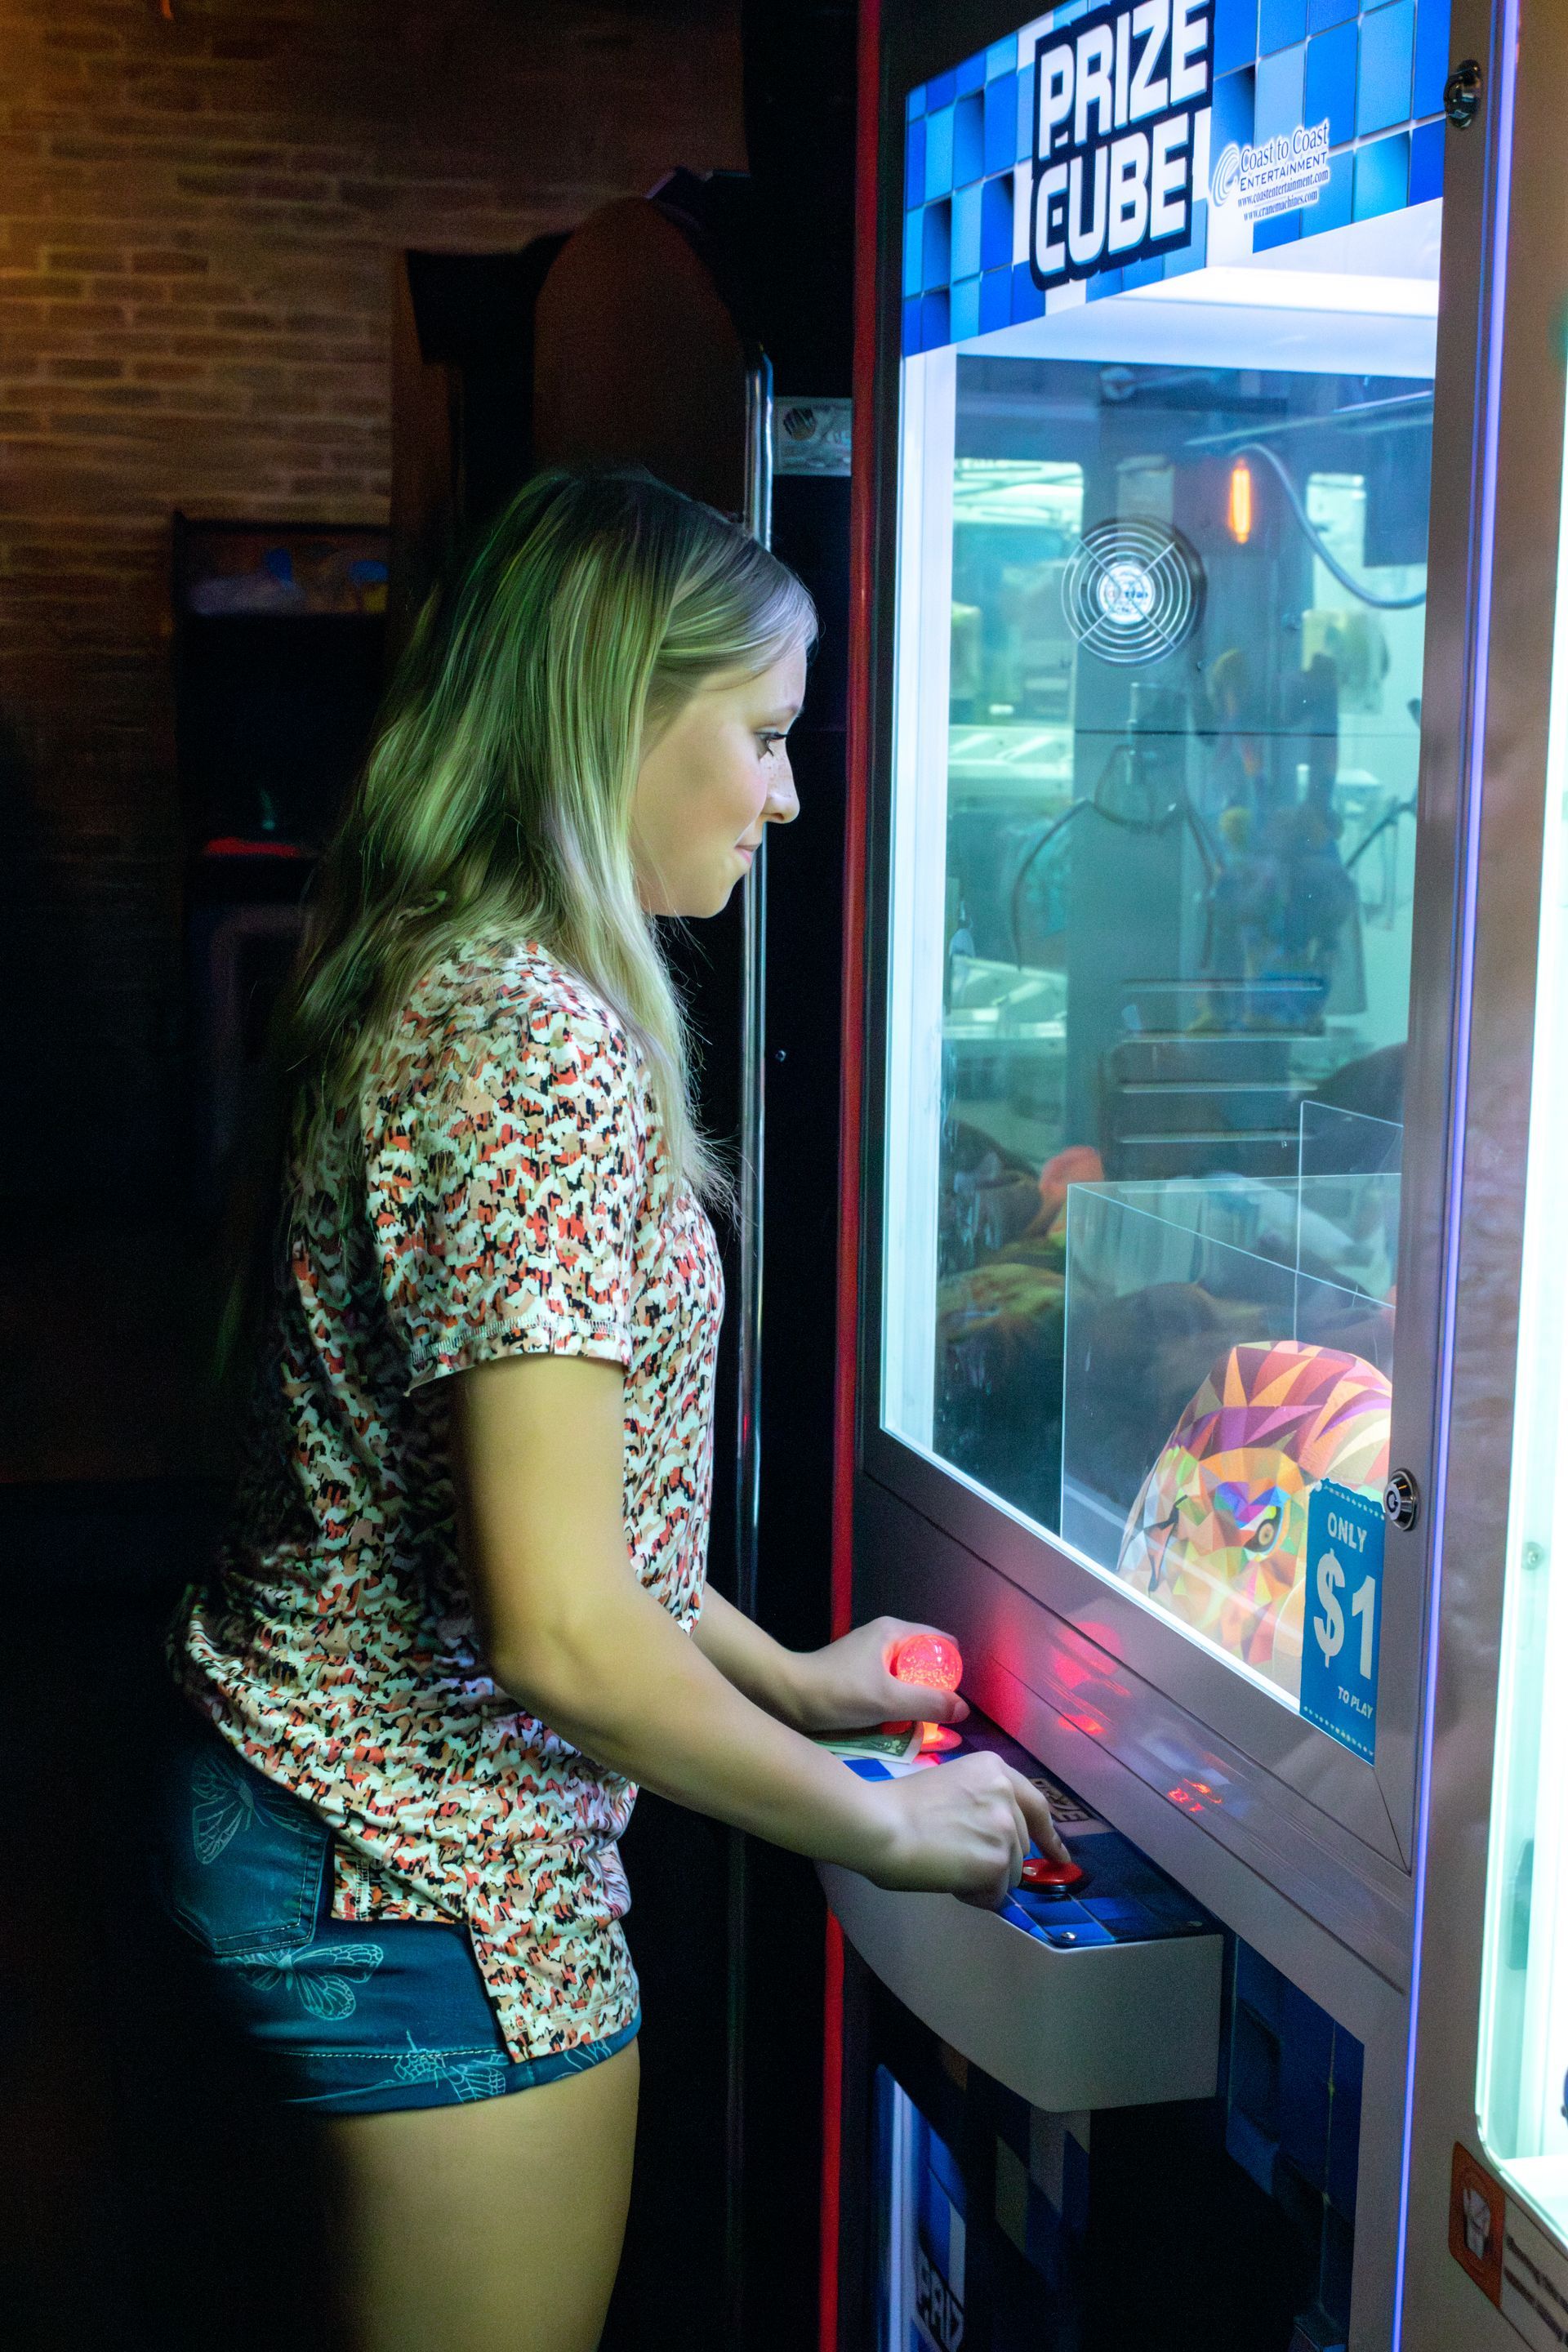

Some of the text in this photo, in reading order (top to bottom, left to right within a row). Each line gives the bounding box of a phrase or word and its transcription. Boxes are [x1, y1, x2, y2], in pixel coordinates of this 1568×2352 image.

[1038, 0, 1209, 163] PRIZE
[1241, 122, 1328, 173] Coast to Coast
[1237, 169, 1329, 207] www.coastentertainment.com
[1240, 151, 1328, 192] ENTERTAINMENT
[1035, 111, 1190, 277] CUBE
[1244, 189, 1318, 221] www.cranemachines.com
[1327, 1512, 1368, 1553] ONLY
[1313, 1547, 1376, 1681] $1
[1338, 1685, 1374, 1720] TO PLAY
